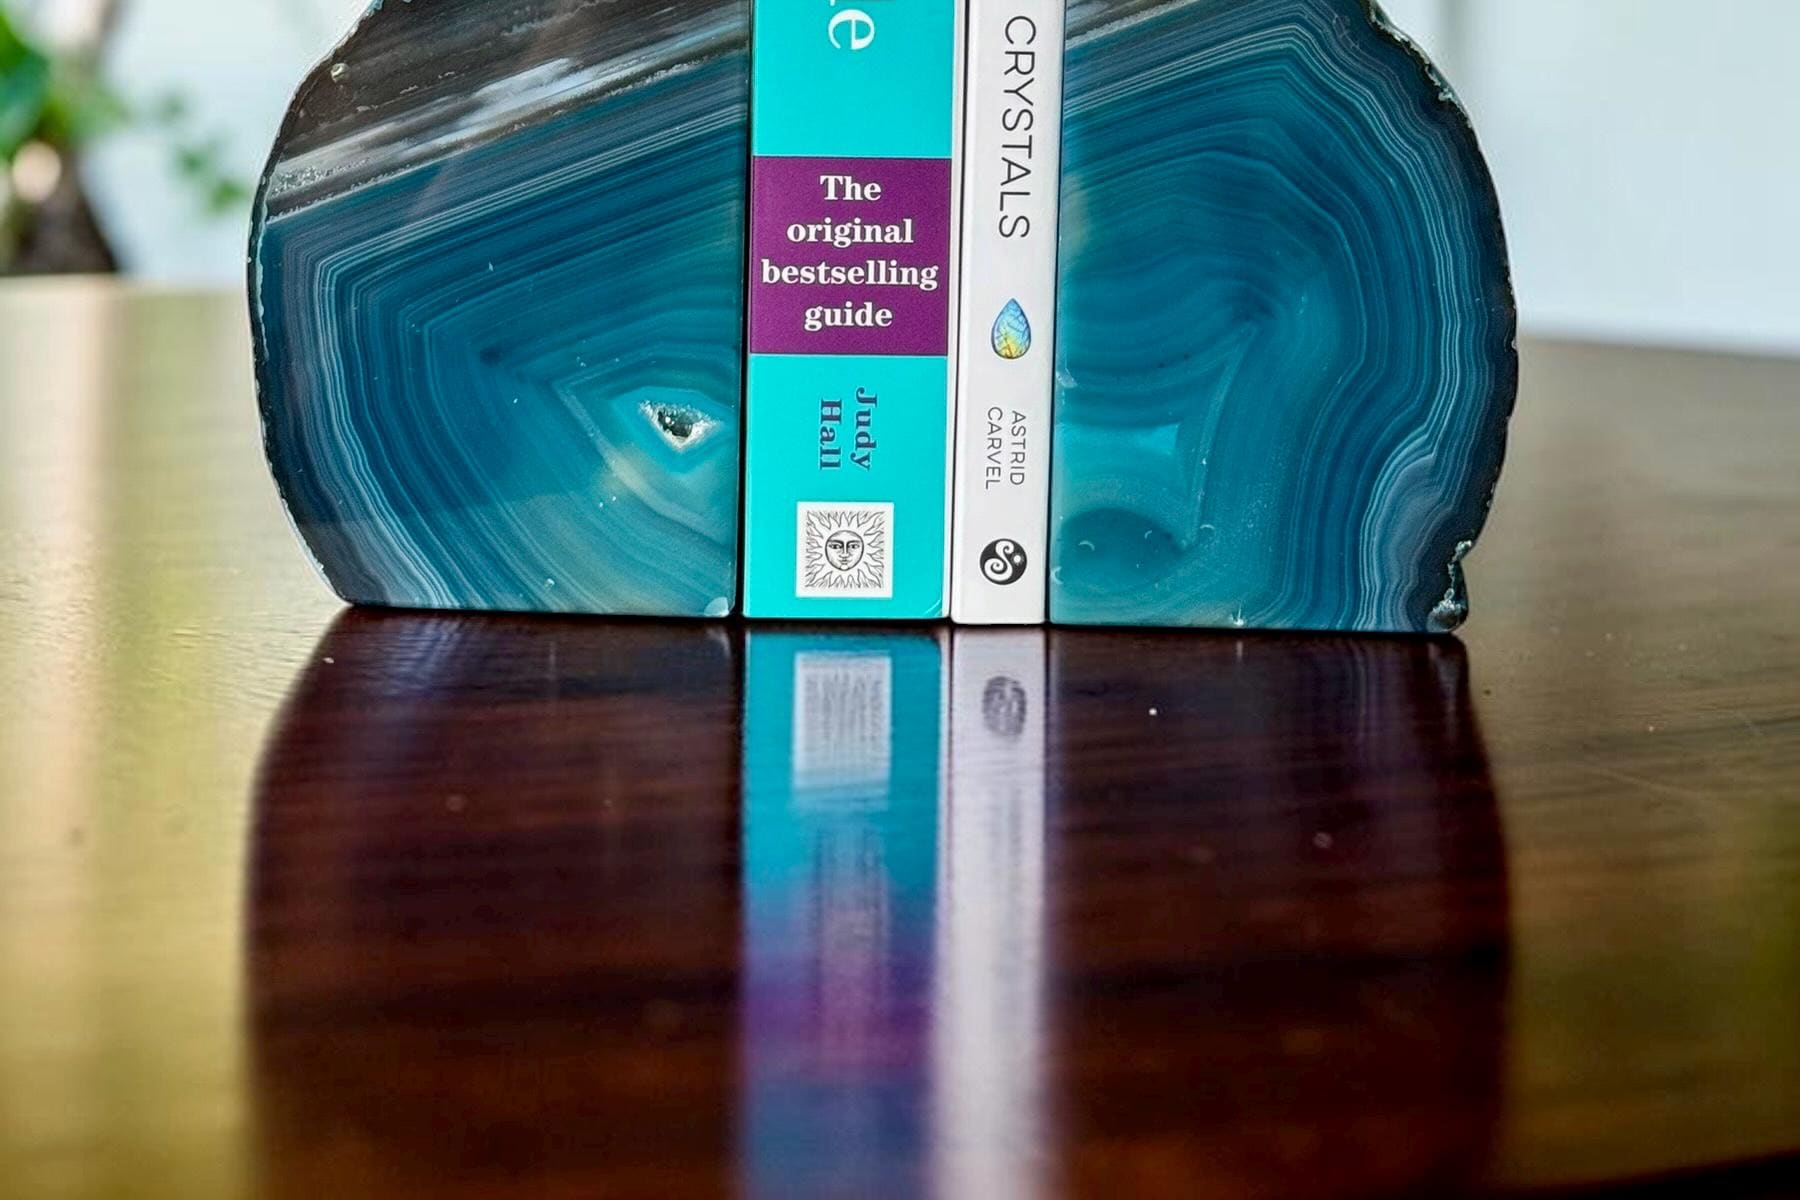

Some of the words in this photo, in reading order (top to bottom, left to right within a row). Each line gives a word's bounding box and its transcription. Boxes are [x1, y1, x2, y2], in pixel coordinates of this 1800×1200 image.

[998, 15, 1037, 240] CRYSTALS
[819, 174, 882, 202] The
[786, 218, 914, 249] original
[760, 258, 939, 291] bestselling
[803, 301, 893, 333] guide
[818, 397, 843, 472] Hall
[849, 386, 879, 471] Judy
[984, 406, 1004, 490] CARVEL
[1008, 409, 1027, 487] ASTRID
